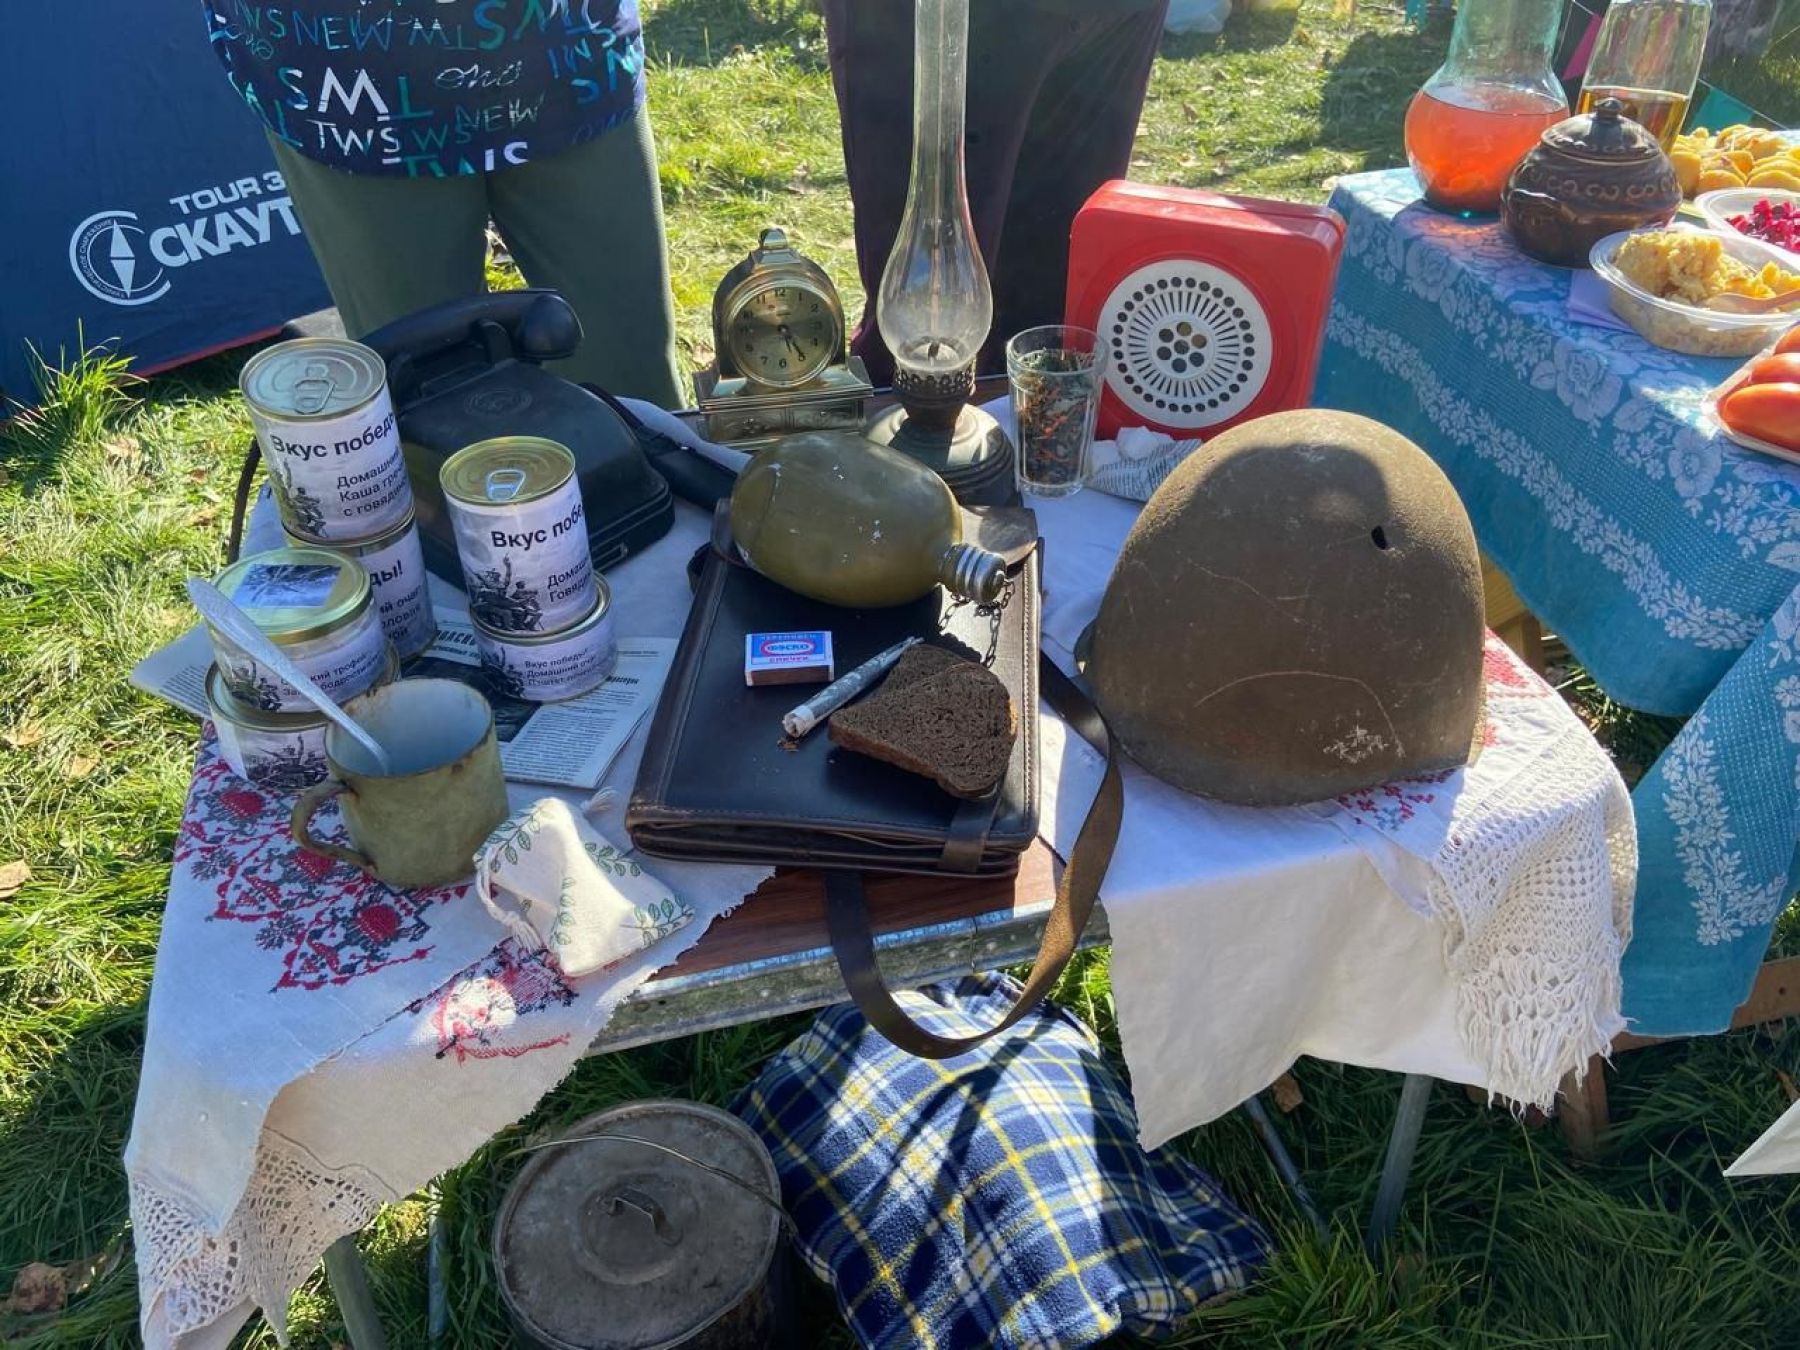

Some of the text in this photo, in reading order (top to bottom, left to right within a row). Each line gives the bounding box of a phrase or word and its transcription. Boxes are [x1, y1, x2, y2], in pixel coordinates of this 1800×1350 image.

[169, 170, 286, 215] TOUR 3
[149, 196, 302, 268] СКАУТ
[270, 434, 327, 461] Вкус
[339, 483, 380, 502] Каша
[491, 529, 548, 551] Вкус
[525, 660, 548, 669] Вкус
